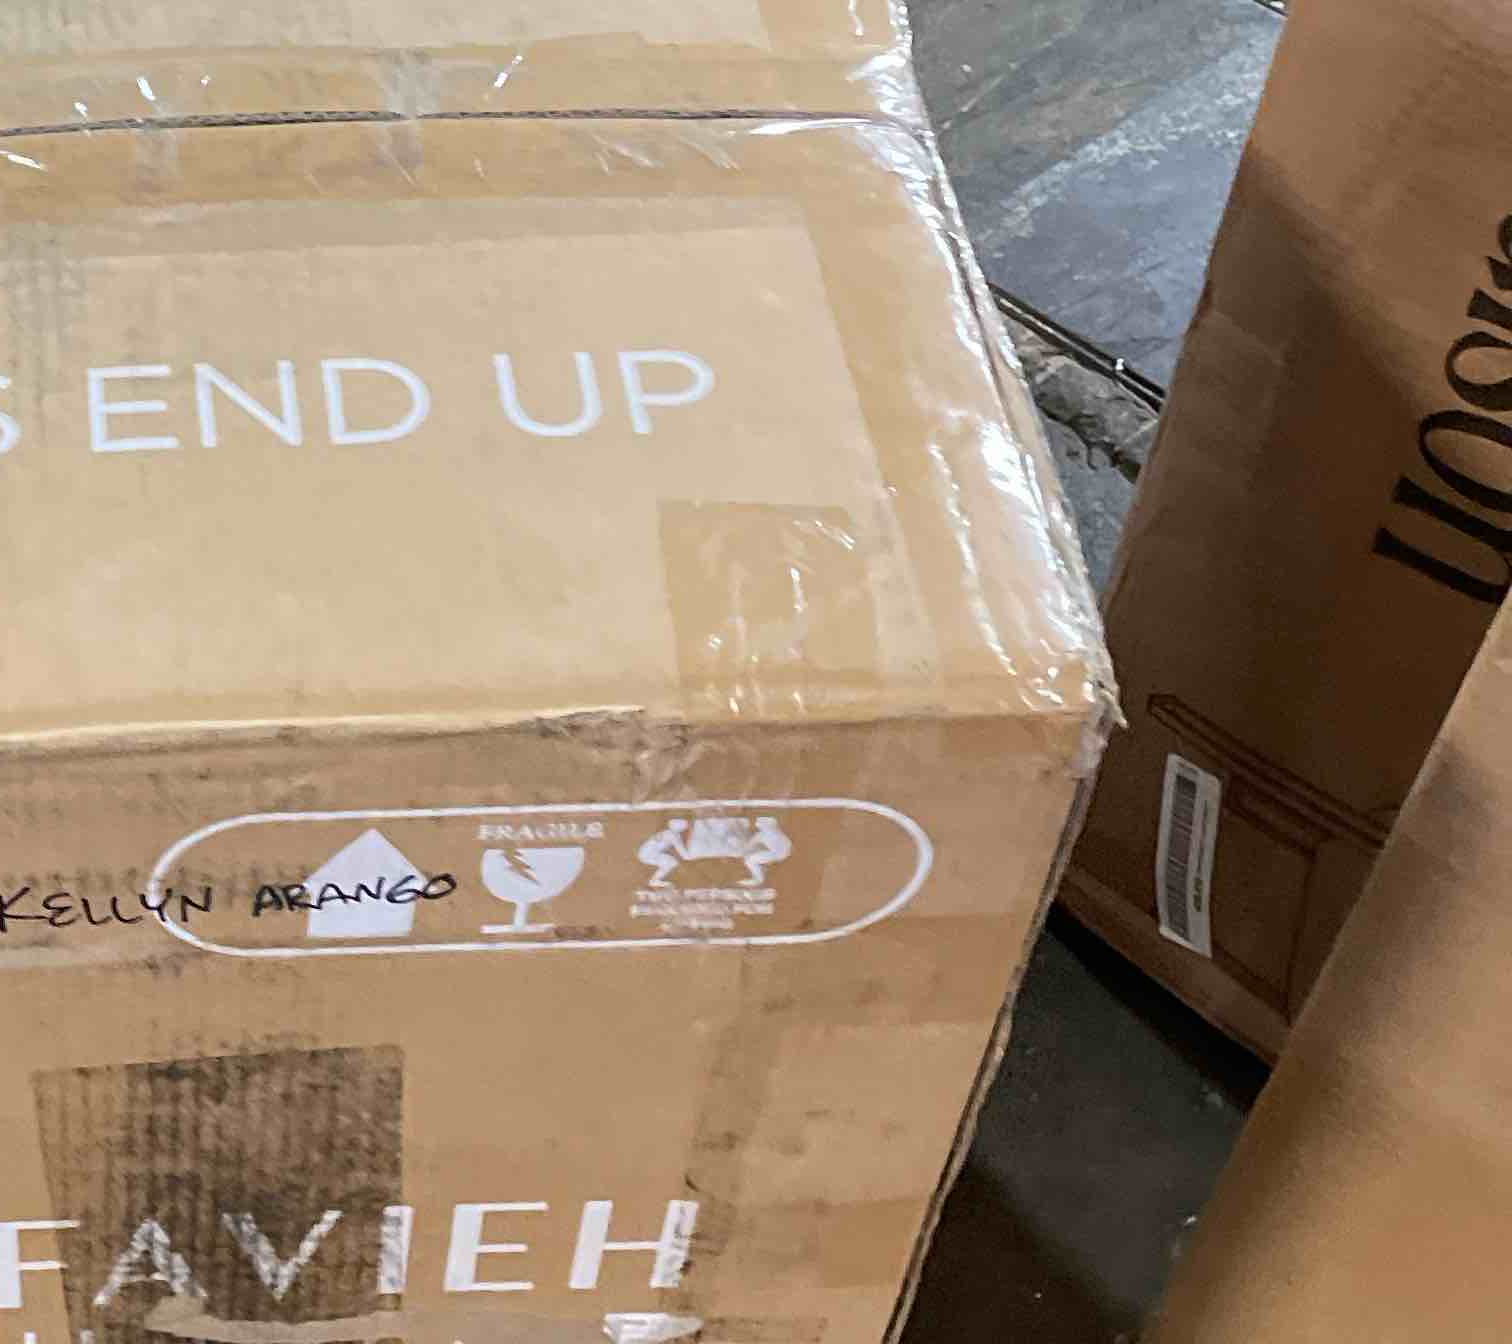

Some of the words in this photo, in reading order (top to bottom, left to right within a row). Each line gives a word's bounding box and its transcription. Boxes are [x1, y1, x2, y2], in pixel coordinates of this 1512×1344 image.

[86, 358, 432, 453] END
[491, 348, 715, 438] UP
[252, 872, 457, 918] ARANGO
